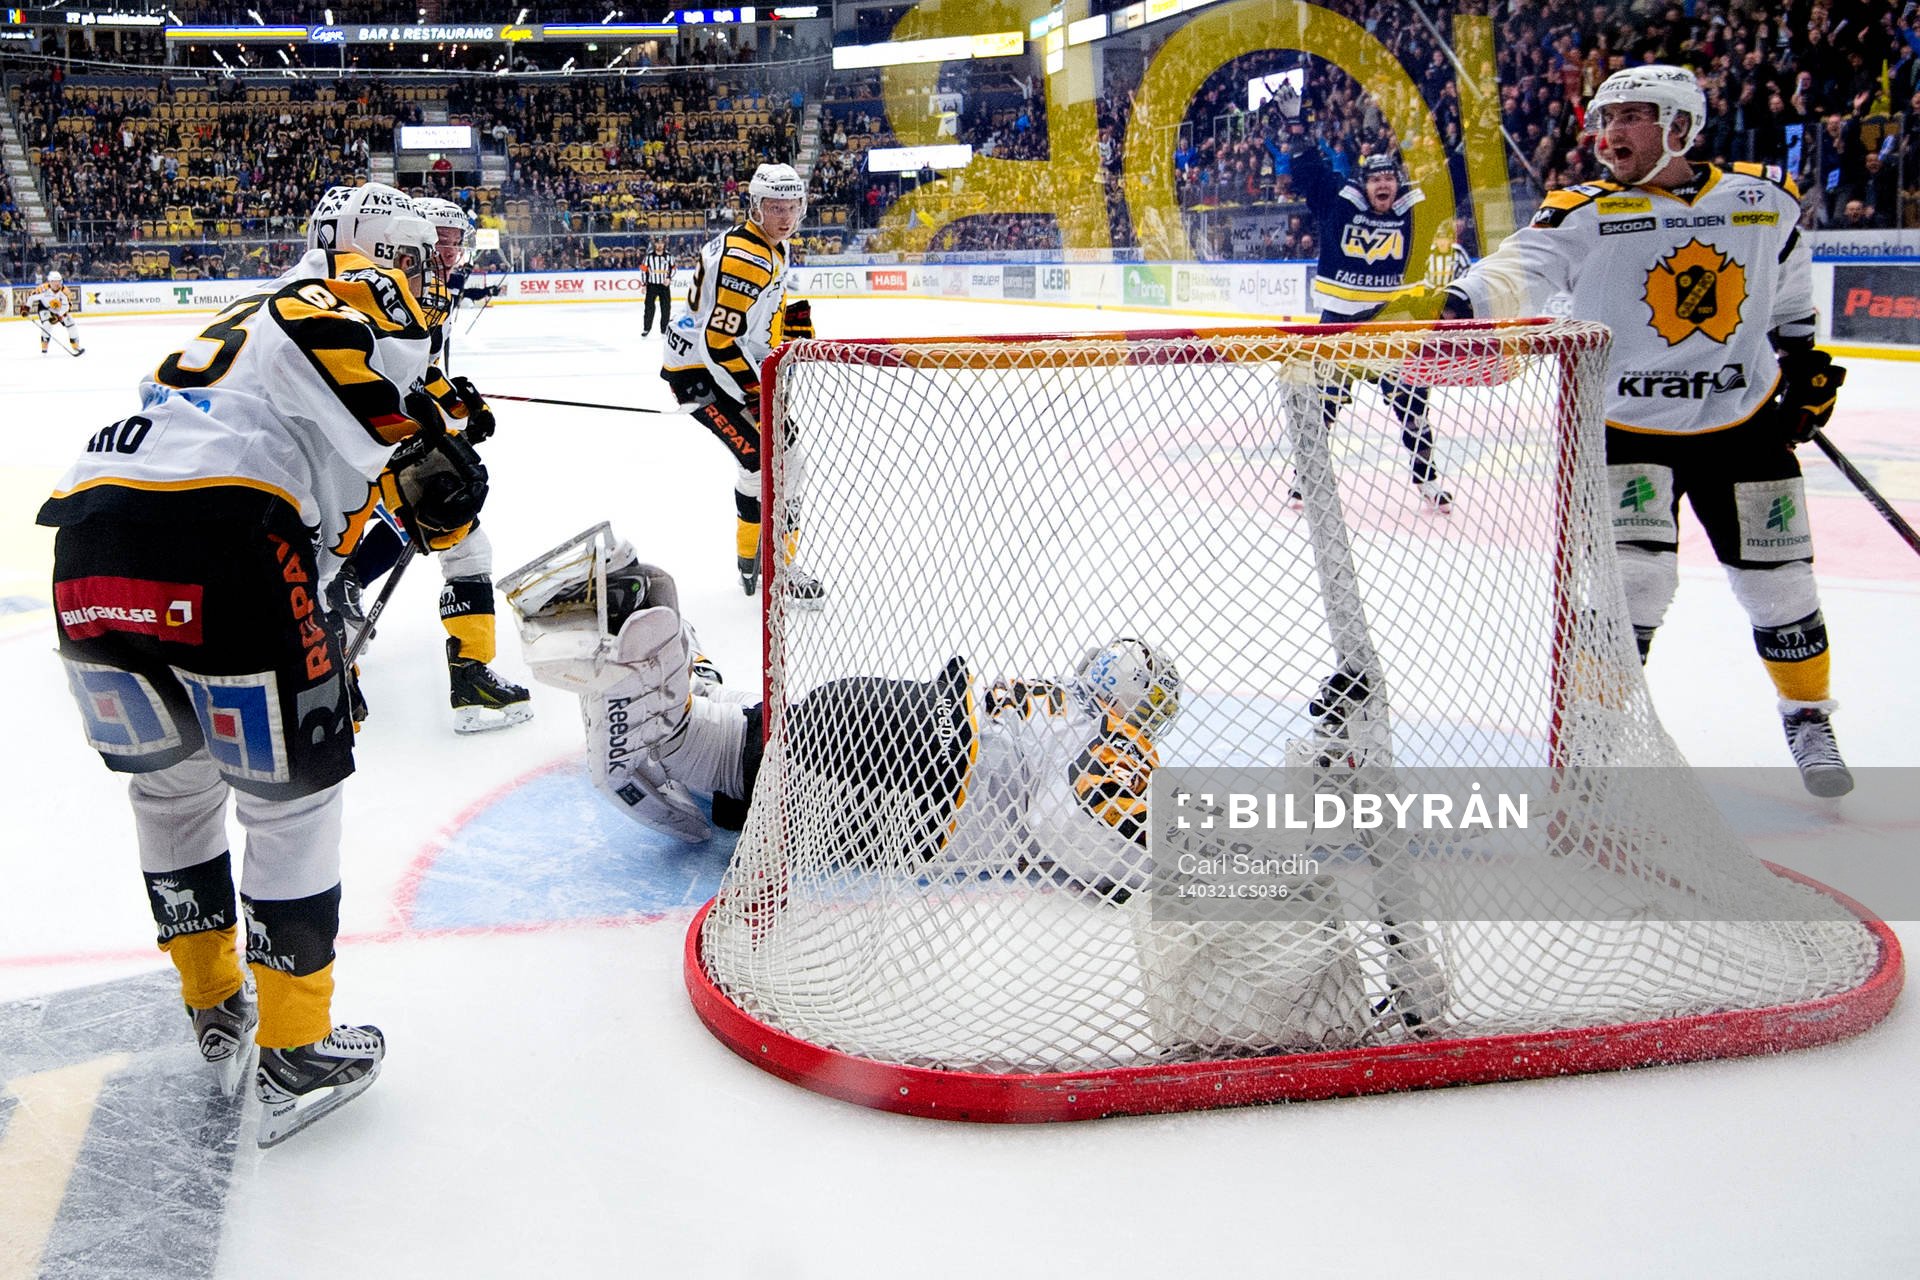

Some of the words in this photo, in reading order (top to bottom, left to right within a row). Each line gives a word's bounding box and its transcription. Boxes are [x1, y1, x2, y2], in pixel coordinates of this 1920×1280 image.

[358, 28, 387, 40] BAR
[390, 28, 401, 40] &
[403, 27, 494, 41] RESTAURANG
[1602, 221, 1653, 234] ŠKODA
[1665, 215, 1725, 229] BOLIDEN
[374, 243, 394, 260] 63
[520, 280, 549, 290] SEW
[554, 279, 584, 290] SEW
[594, 278, 641, 291] RICO
[874, 275, 905, 287] HABIL
[1336, 270, 1404, 286] FAGERHULT
[1142, 281, 1166, 304] bring
[1240, 279, 1256, 294] AD
[1261, 278, 1297, 296] PLAST
[1844, 287, 1920, 319] Pas
[709, 307, 742, 333] 29
[704, 403, 756, 456] REPAY
[266, 532, 332, 681] REPAY
[1765, 638, 1824, 660] NORRAN
